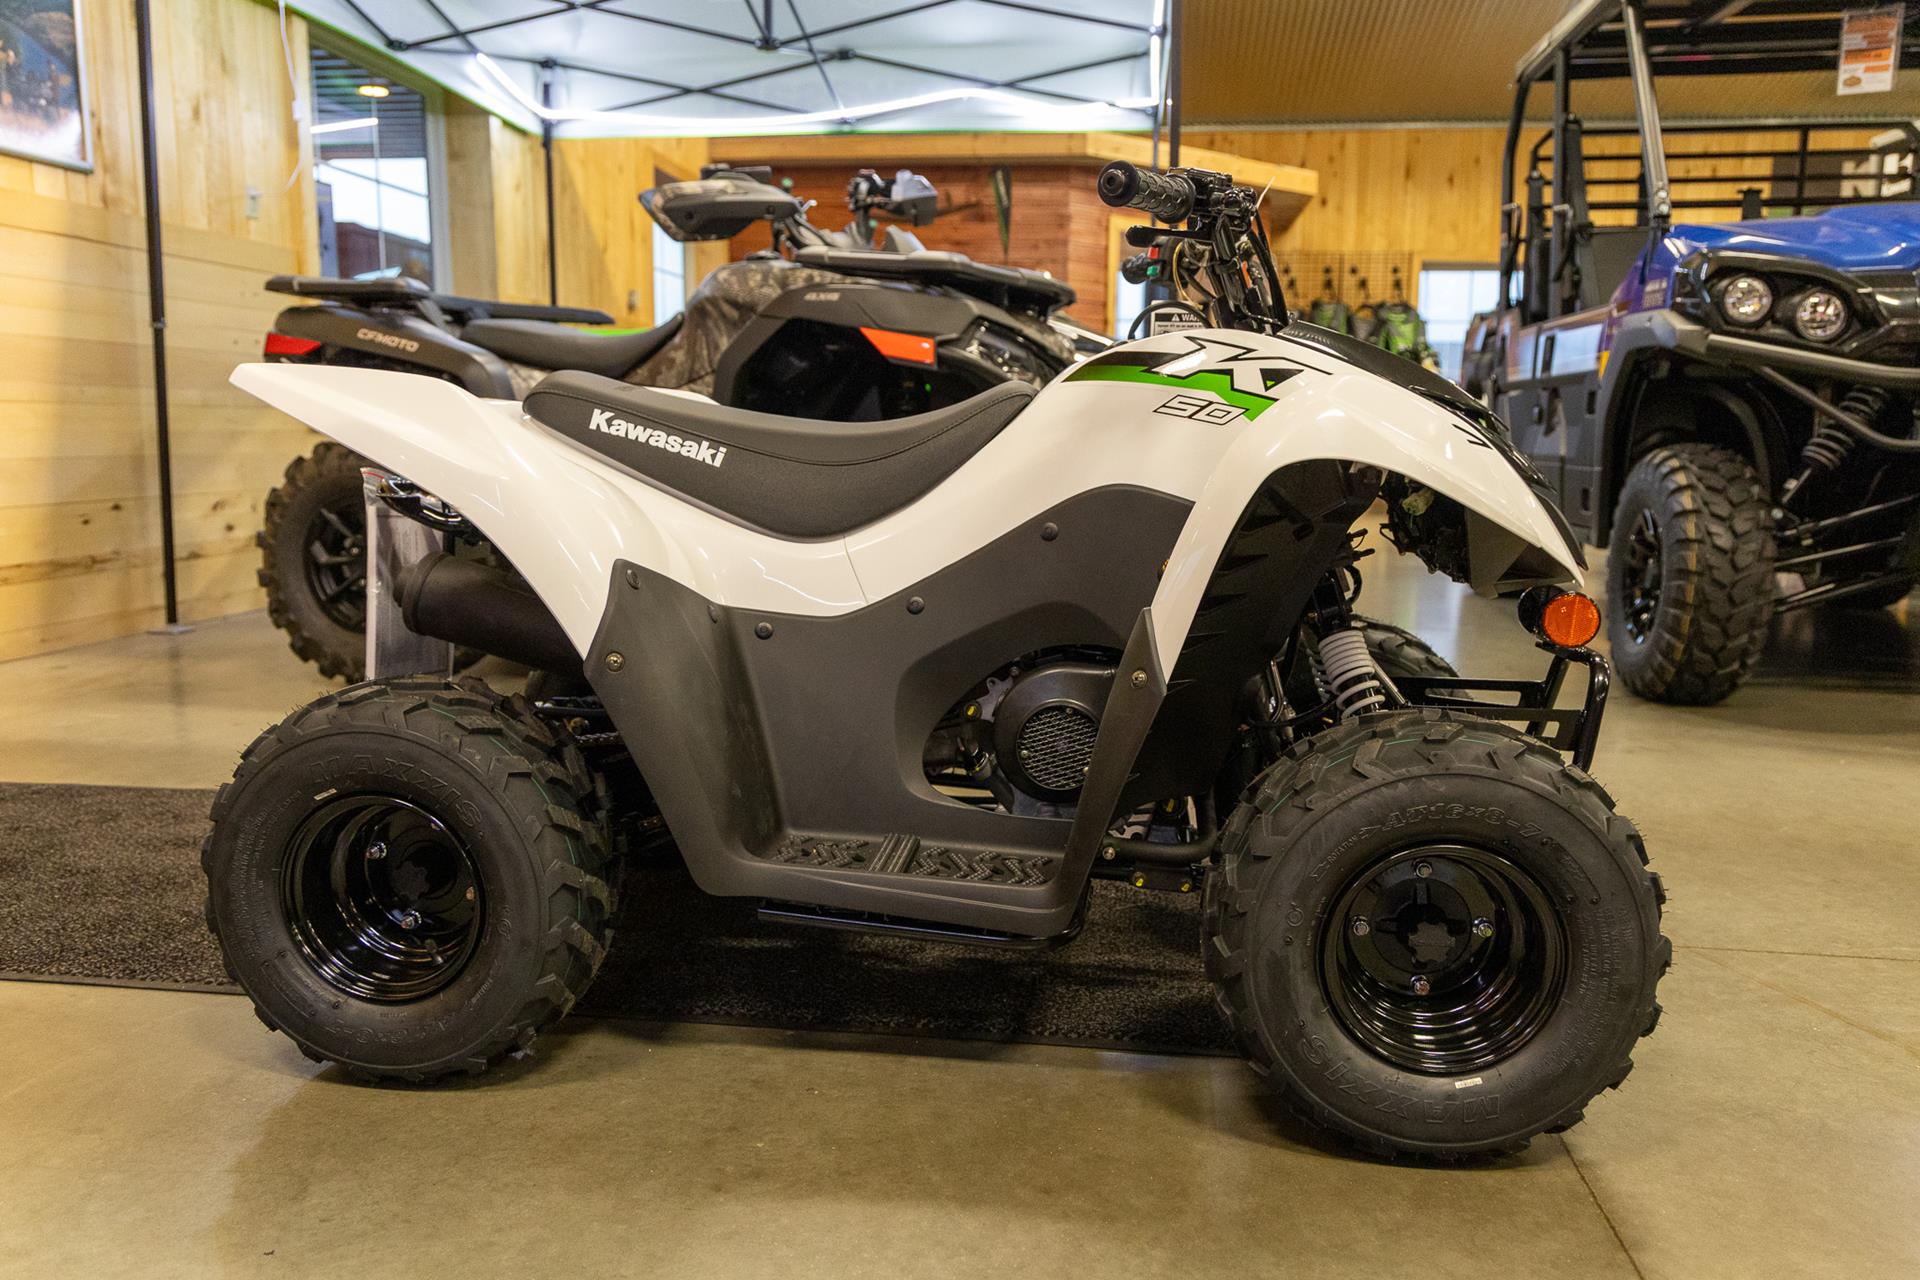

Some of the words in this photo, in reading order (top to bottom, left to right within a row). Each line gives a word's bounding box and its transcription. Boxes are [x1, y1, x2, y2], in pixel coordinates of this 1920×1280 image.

[356, 327, 420, 353] CFMOTO
[588, 408, 727, 468] Kawasaki
[1153, 394, 1250, 426] 50
[310, 754, 483, 829] MAXXIS
[1301, 1034, 1500, 1124] MAXXIS
